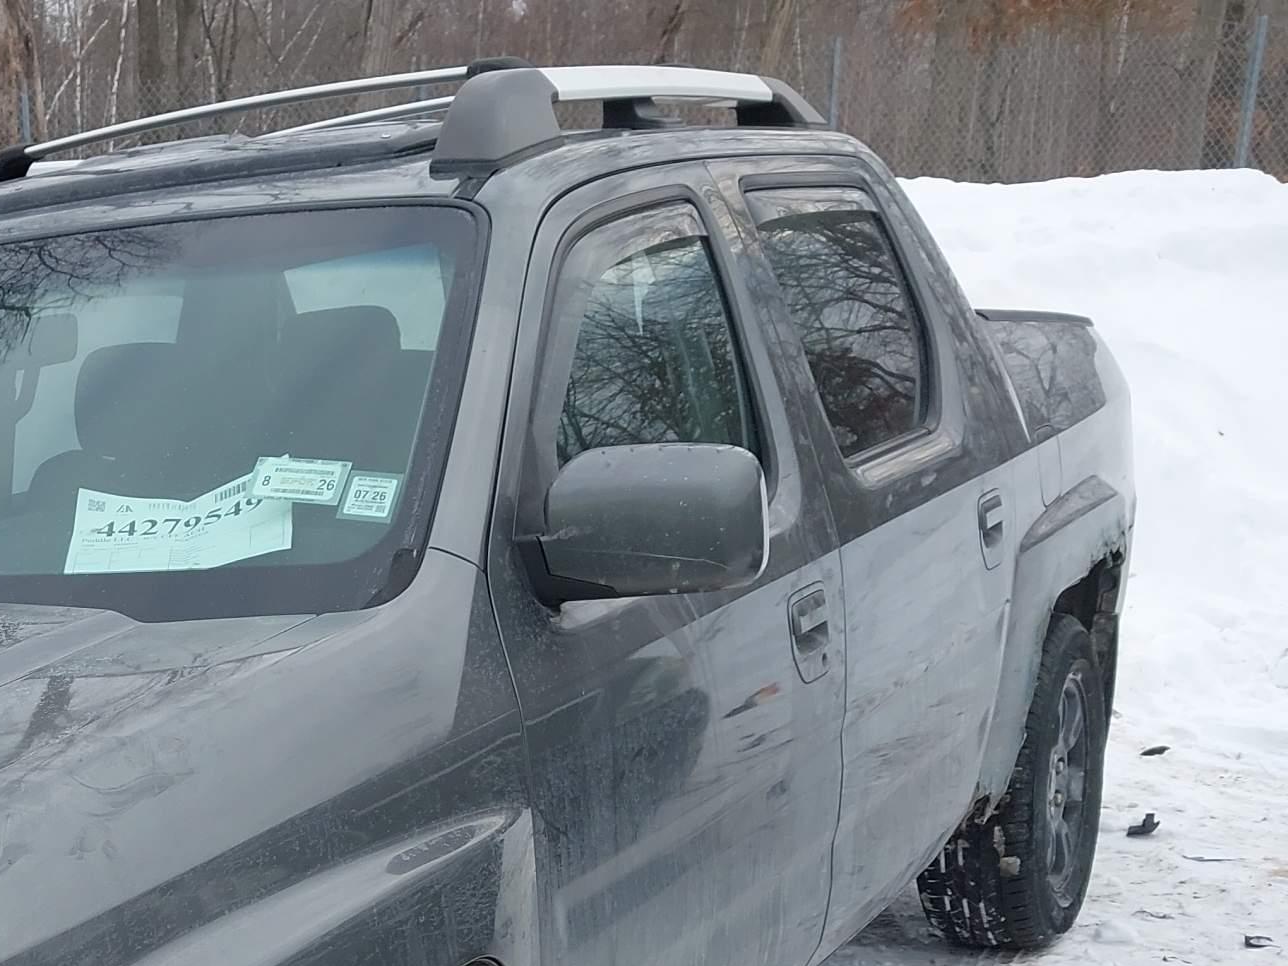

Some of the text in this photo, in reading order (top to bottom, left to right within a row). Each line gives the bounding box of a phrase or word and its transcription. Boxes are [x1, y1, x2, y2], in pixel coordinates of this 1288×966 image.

[261, 475, 272, 487] 8
[316, 479, 336, 491] 26
[353, 489, 388, 501] 07 26
[91, 498, 263, 537] 44279549
